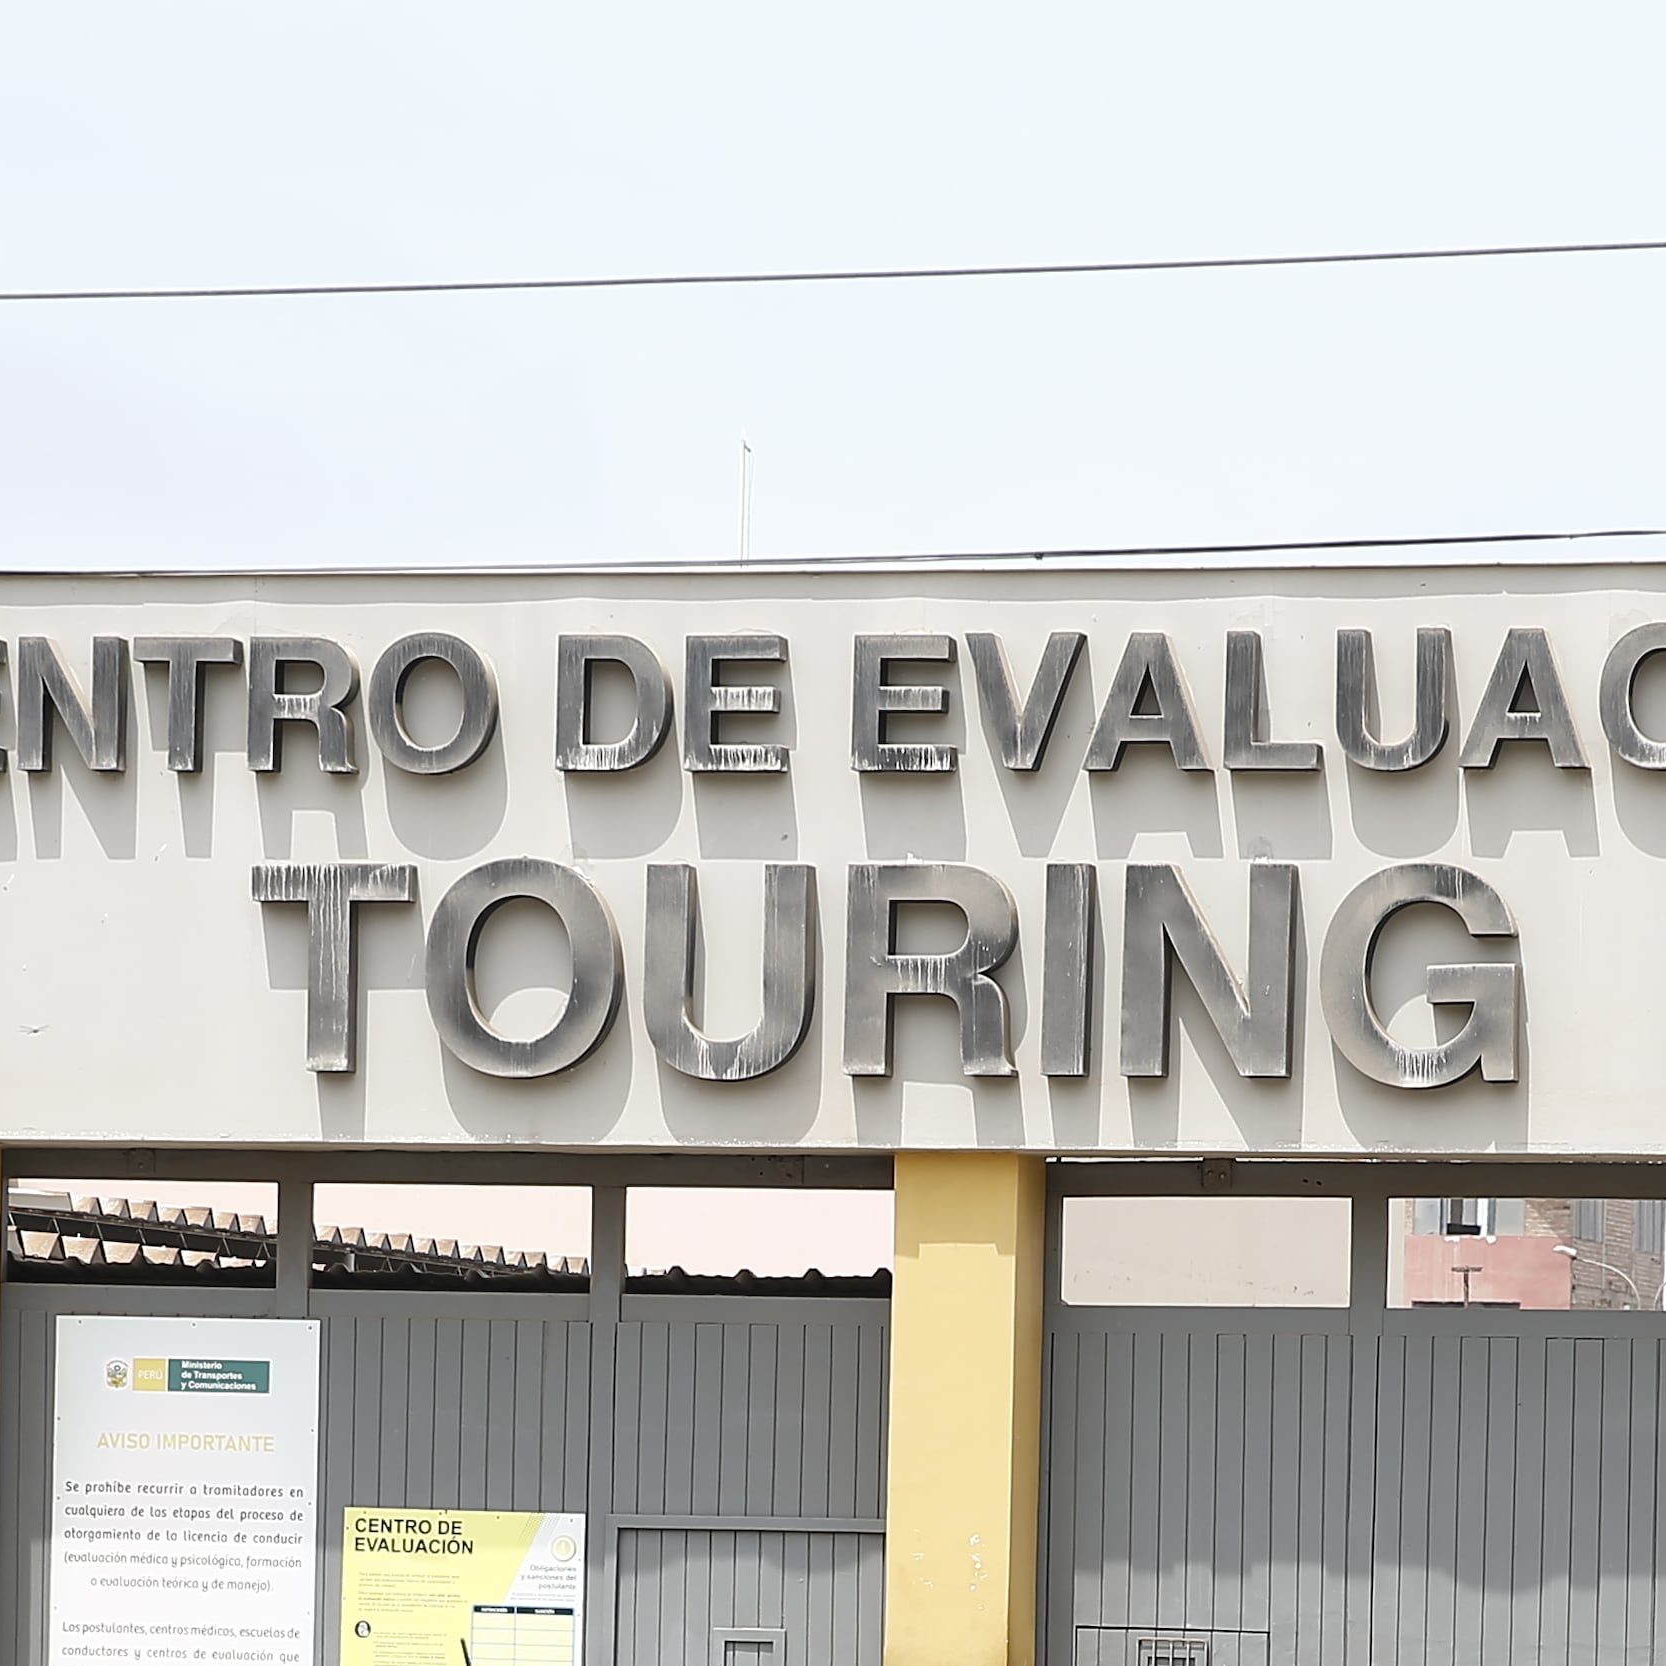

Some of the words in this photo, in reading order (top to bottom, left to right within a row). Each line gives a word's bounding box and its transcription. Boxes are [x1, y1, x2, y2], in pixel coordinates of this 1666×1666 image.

[555, 634, 790, 774] DE
[251, 856, 1520, 1089] TOURING
[181, 1360, 223, 1370] Ministerio
[181, 1370, 192, 1379] de
[193, 1370, 243, 1383] Transportes
[188, 1380, 257, 1390] Comunicaciones
[96, 1432, 150, 1449] AVISO
[157, 1433, 275, 1452] IMPORTANTE
[65, 1481, 79, 1492] Se
[85, 1480, 131, 1495] prohíbe
[137, 1483, 184, 1494] recurrir
[203, 1484, 283, 1497] tramitadores
[289, 1488, 304, 1498] en
[65, 1504, 125, 1519] cualquiera
[131, 1506, 145, 1517] de
[150, 1506, 167, 1518] las
[173, 1507, 211, 1521] etapas
[216, 1508, 234, 1520] del
[240, 1511, 284, 1522] proceso
[289, 1510, 303, 1521] de
[64, 1527, 141, 1543] otorgamiento
[147, 1529, 161, 1541] de
[166, 1530, 177, 1541] la
[183, 1530, 227, 1543] licencia
[233, 1532, 247, 1543] de
[253, 1533, 303, 1544] conducir
[355, 1518, 431, 1534] CENTRO
[438, 1521, 463, 1535] DE
[355, 1536, 473, 1554] EVALUACIÓN
[64, 1551, 127, 1564] (evaluación
[130, 1552, 169, 1565] médica
[246, 1555, 302, 1568] formación
[99, 1576, 159, 1588] evaluación
[162, 1576, 199, 1589] teórica
[211, 1578, 225, 1590] de
[62, 1621, 81, 1633] Los
[82, 1622, 147, 1636] postulantes,
[149, 1624, 189, 1635] centros
[190, 1624, 237, 1638] médicos,
[239, 1627, 286, 1638] escuelas
[287, 1628, 301, 1639] de
[61, 1645, 129, 1657] conductores
[146, 1648, 187, 1659] centros
[193, 1648, 207, 1660] de
[211, 1649, 273, 1661] evaluación
[279, 1653, 300, 1664] que
